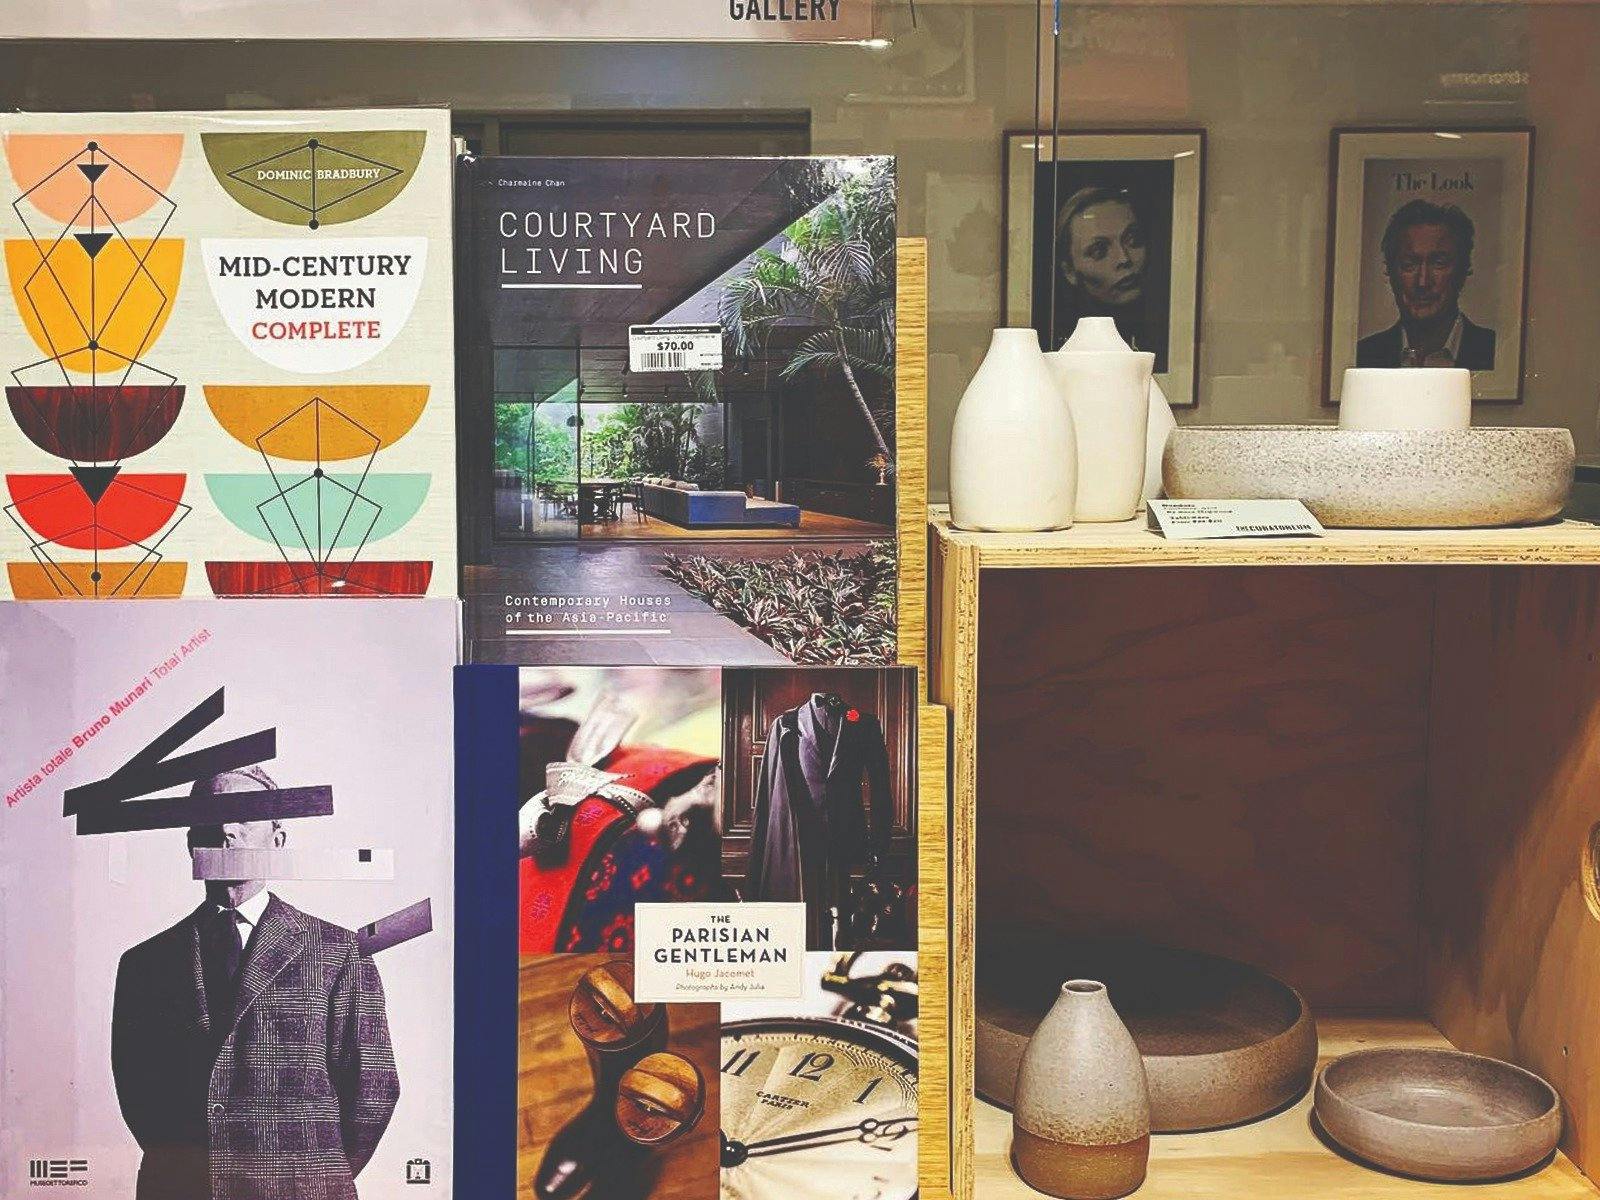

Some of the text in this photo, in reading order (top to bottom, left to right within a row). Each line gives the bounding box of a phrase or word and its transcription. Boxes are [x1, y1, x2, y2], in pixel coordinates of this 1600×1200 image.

[729, 0, 840, 21] GALLERY
[257, 168, 381, 181] DOMINIC BRADBURY
[1393, 171, 1474, 191] The Look
[497, 179, 565, 187] Charmaine Chan
[499, 211, 717, 239] COURTYARD
[219, 255, 412, 277] MID-CENTURY
[501, 247, 643, 275] LIVING
[255, 287, 376, 309] MODERN
[252, 320, 381, 339] COMPLETE
[656, 340, 694, 351] $70.00
[505, 595, 672, 608] Contemporary Houses
[505, 611, 668, 623] of the Asia-Pacific
[5, 628, 213, 808] Artista totale Bruno Munari Total Artist
[710, 915, 731, 924] THE
[672, 928, 769, 943] PARISIAN
[654, 948, 787, 963] GENTLEMAN
[686, 969, 755, 980] Hugo Jacomet
[720, 983, 729, 992] by
[730, 983, 748, 991] Andy
[787, 1052, 835, 1082] 12
[755, 1090, 812, 1108] CARTIER
[760, 1099, 794, 1111] PARIS
